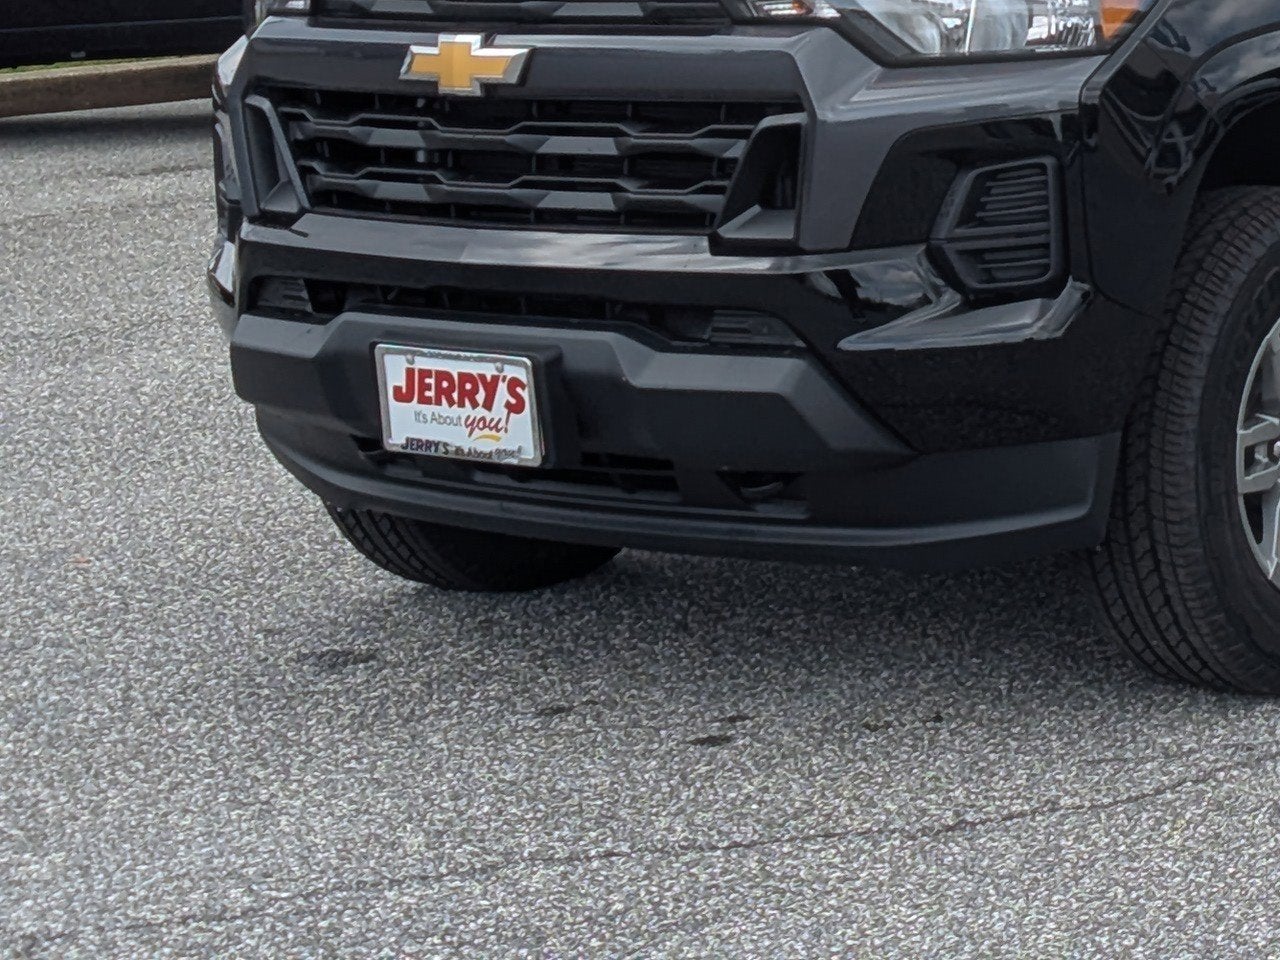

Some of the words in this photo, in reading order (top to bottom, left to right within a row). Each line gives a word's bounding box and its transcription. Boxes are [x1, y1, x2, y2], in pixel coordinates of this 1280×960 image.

[393, 367, 527, 415] JERRY'S
[413, 410, 428, 424] It's
[430, 411, 463, 427] About
[464, 411, 511, 438] you!
